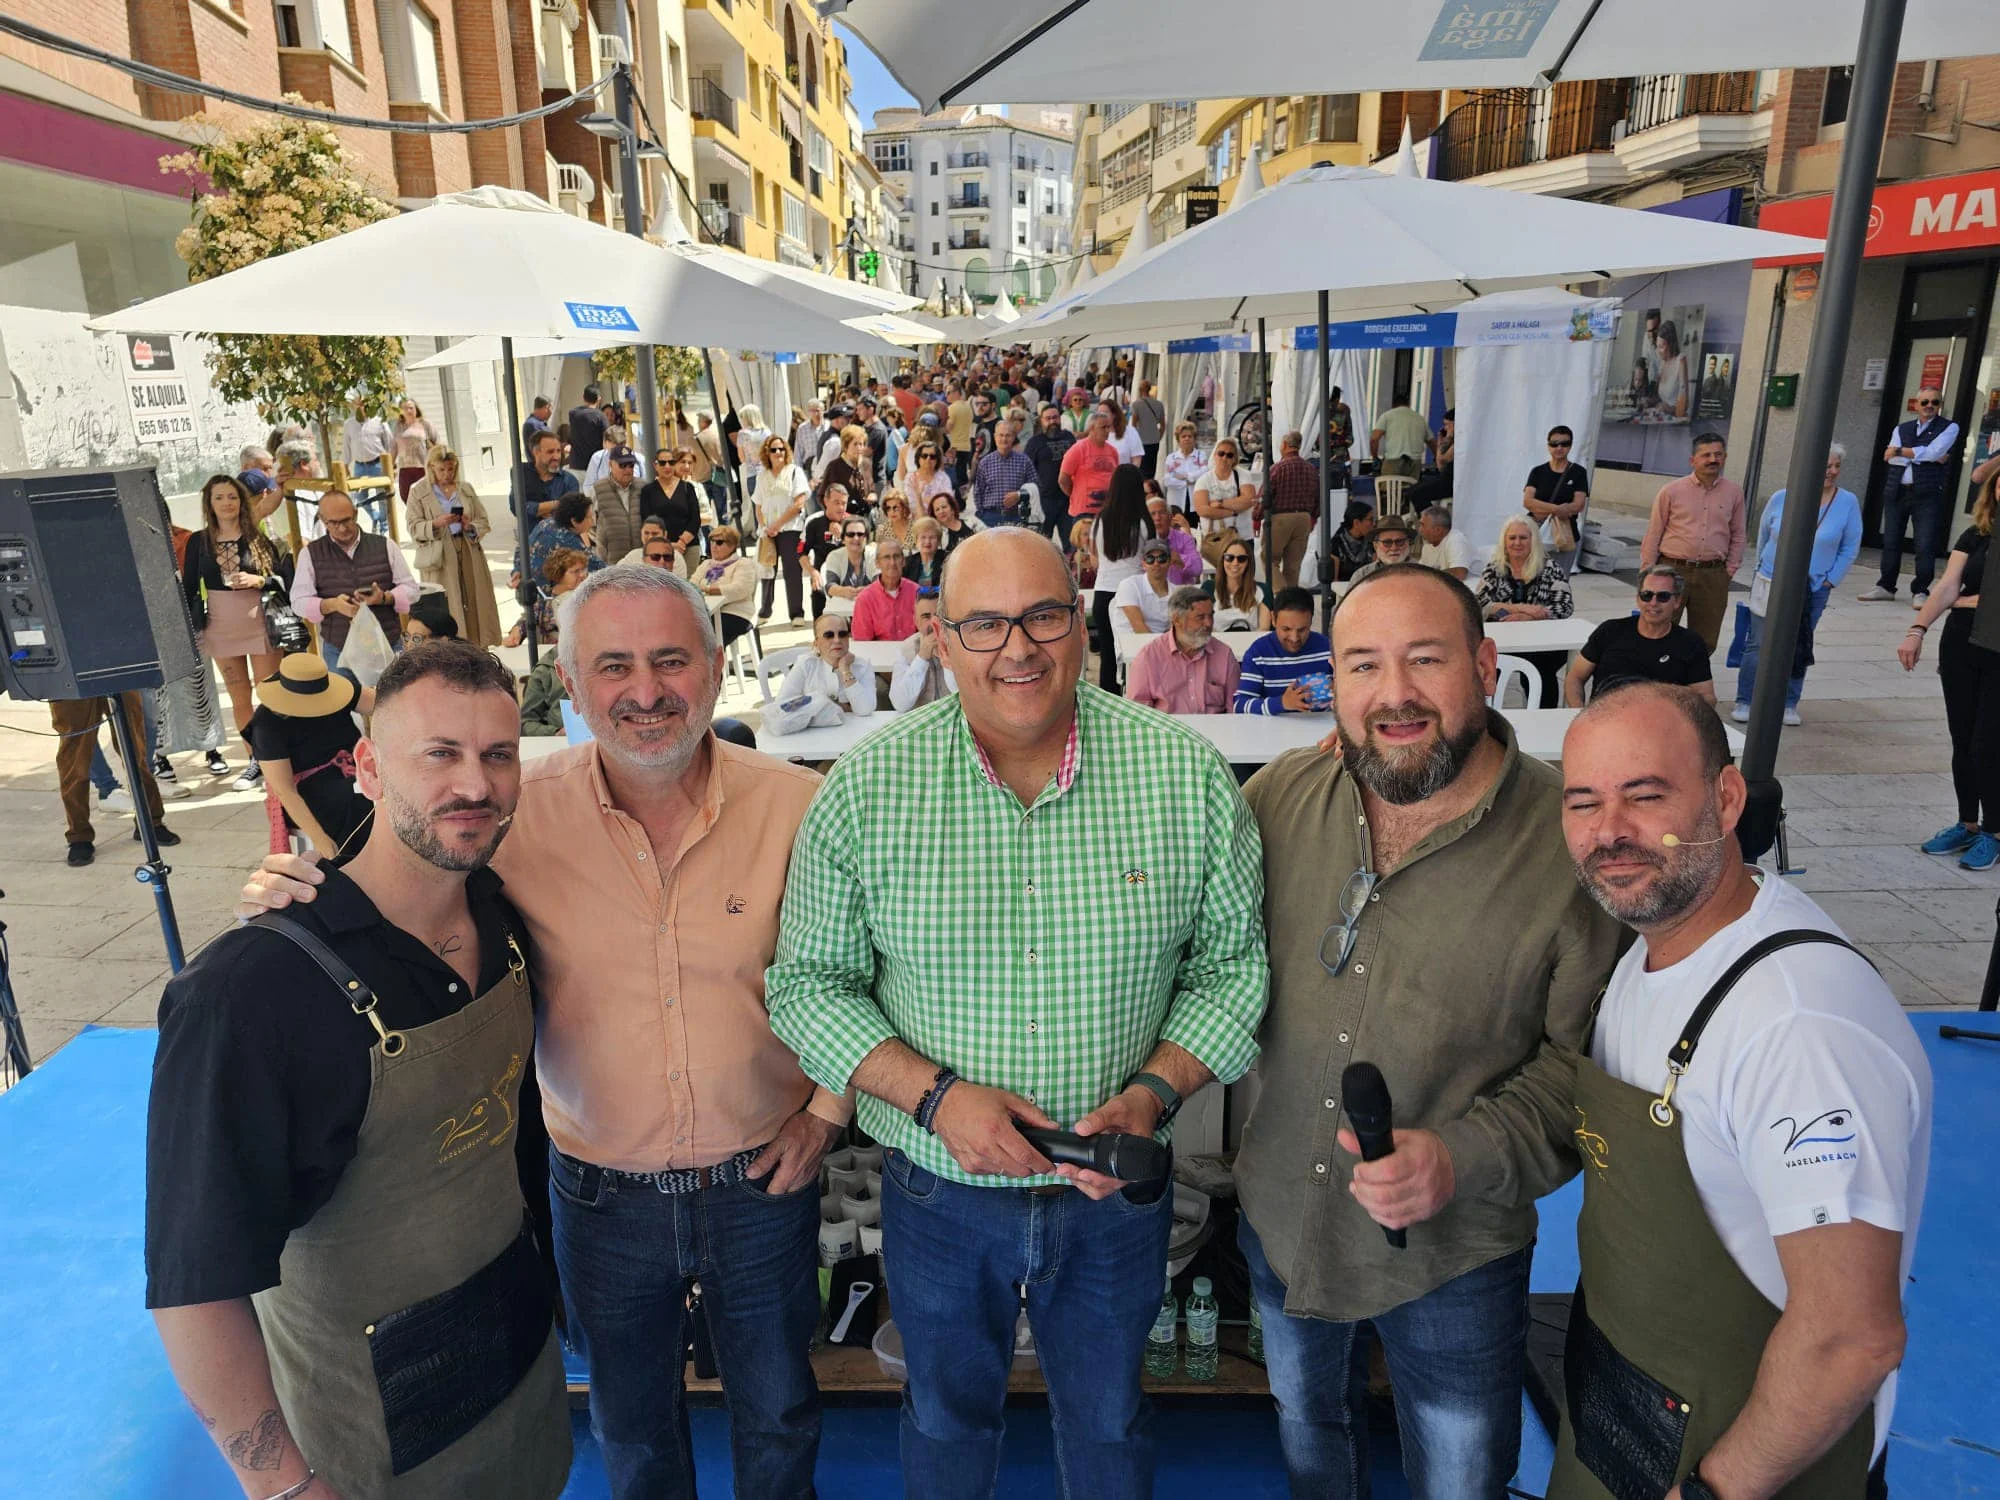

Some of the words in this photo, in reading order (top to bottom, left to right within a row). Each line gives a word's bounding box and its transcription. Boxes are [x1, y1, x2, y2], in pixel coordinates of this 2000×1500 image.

[1909, 187, 1998, 236] MA
[1392, 323, 1427, 333] EXCELENCIA
[1491, 321, 1510, 330] SABOR
[131, 385, 146, 408] SE
[146, 384, 187, 408] ALQUILA
[138, 420, 157, 436] 655
[158, 419, 168, 434] 96
[169, 418, 180, 433] 12
